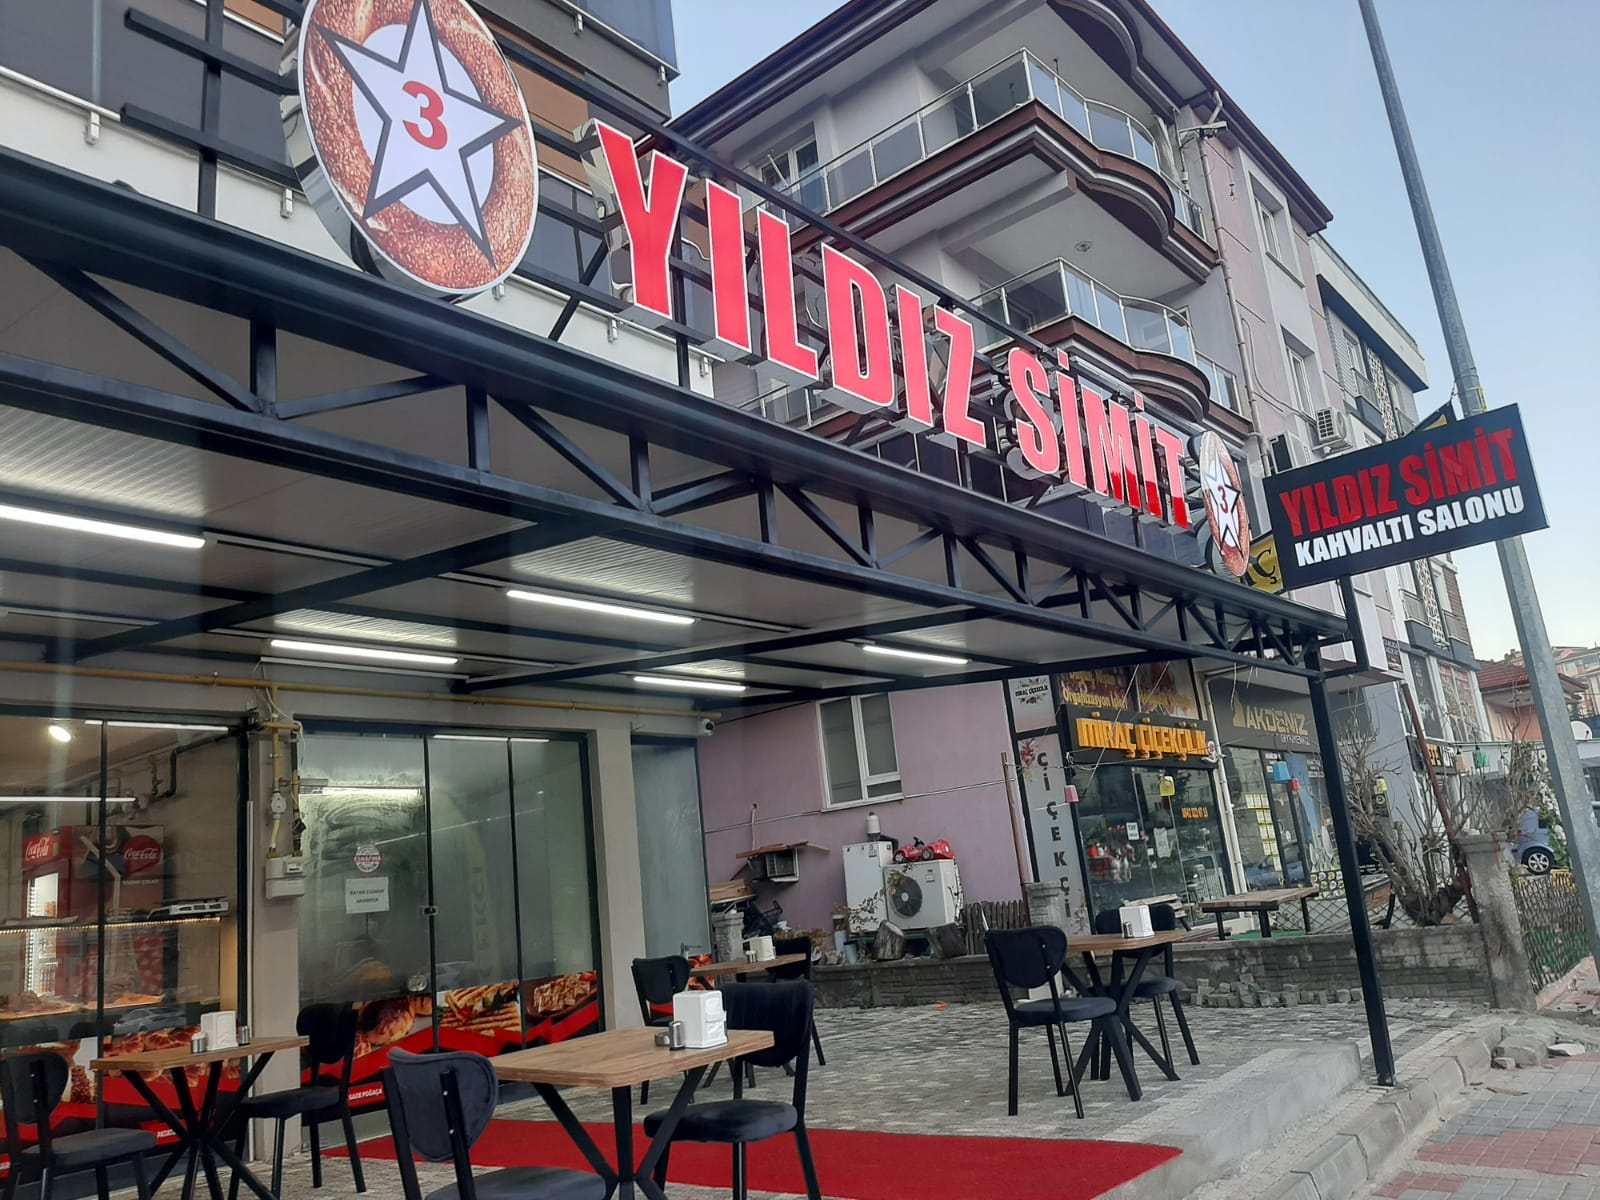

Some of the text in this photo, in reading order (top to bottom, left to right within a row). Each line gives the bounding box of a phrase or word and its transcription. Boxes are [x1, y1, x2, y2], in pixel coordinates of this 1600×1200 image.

[402, 80, 448, 151] 3
[594, 118, 1190, 530] YILDIZ SİMİT
[1216, 484, 1230, 514] 3
[1279, 426, 1519, 537] YILDIZ SİMİT
[1294, 485, 1525, 567] KAHVALTI SALONU
[1076, 711, 1209, 761] MİRAÇ ÇİÇEKÇİLİK
